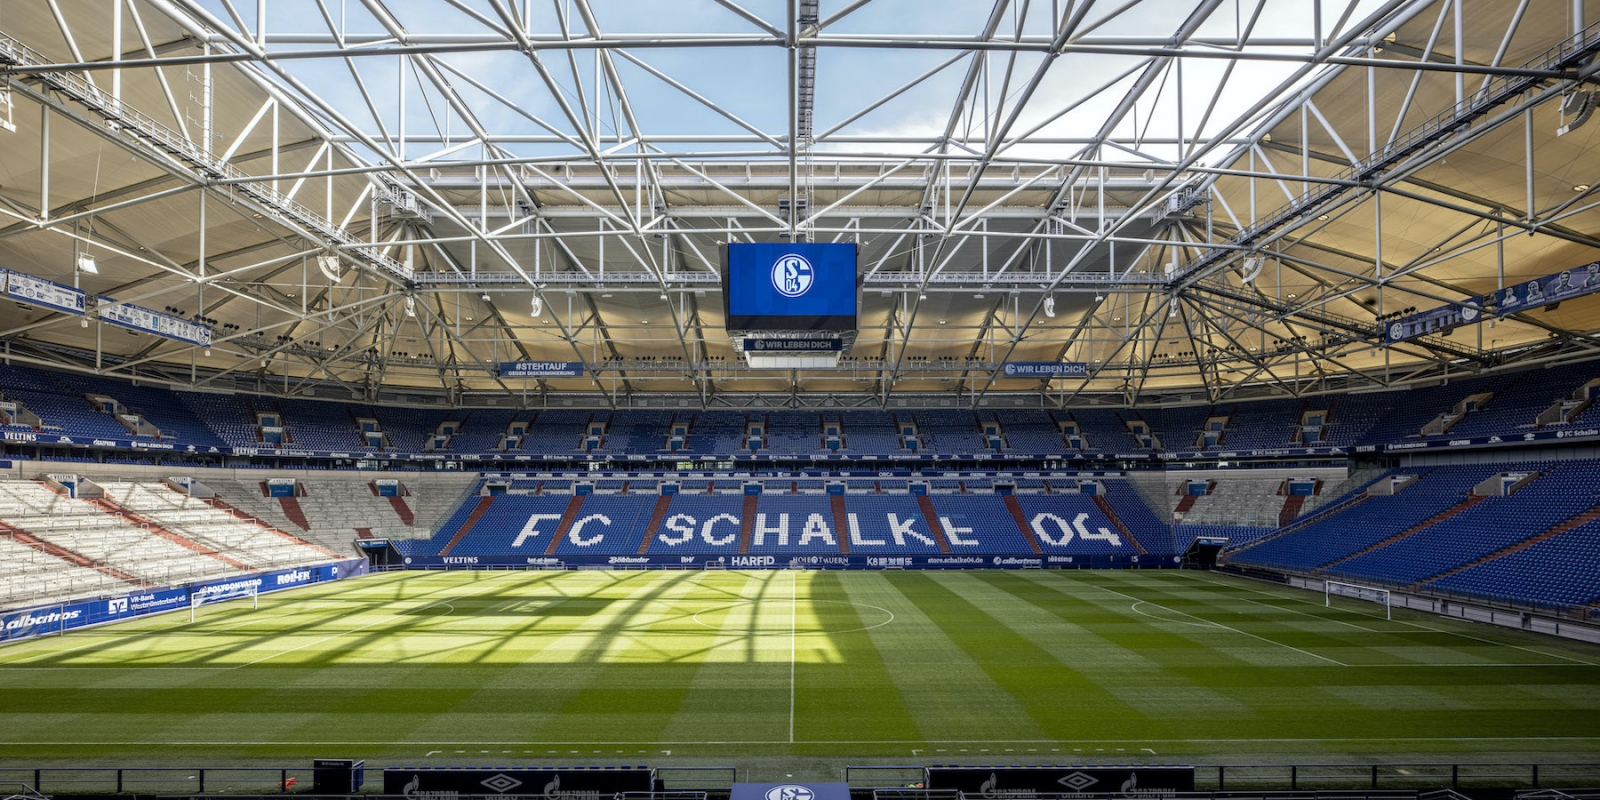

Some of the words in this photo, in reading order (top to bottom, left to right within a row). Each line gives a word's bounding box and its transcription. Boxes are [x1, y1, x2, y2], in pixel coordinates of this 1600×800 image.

[786, 279, 798, 292] 04
[516, 362, 567, 370] #STEHTAUF
[1573, 428, 1598, 436] Schalke
[4, 432, 37, 442] VELTINS
[232, 447, 258, 455] VELTINS
[511, 513, 611, 548] FC
[658, 513, 979, 547] SCHALKE
[1030, 512, 1122, 547] 04
[443, 556, 479, 564] VELTINS
[731, 556, 775, 566] HARFID
[927, 556, 983, 564] store.schalke04.de
[1002, 557, 1042, 565] albatros
[130, 593, 155, 603] VR-Bank
[6, 610, 79, 628] albatros
